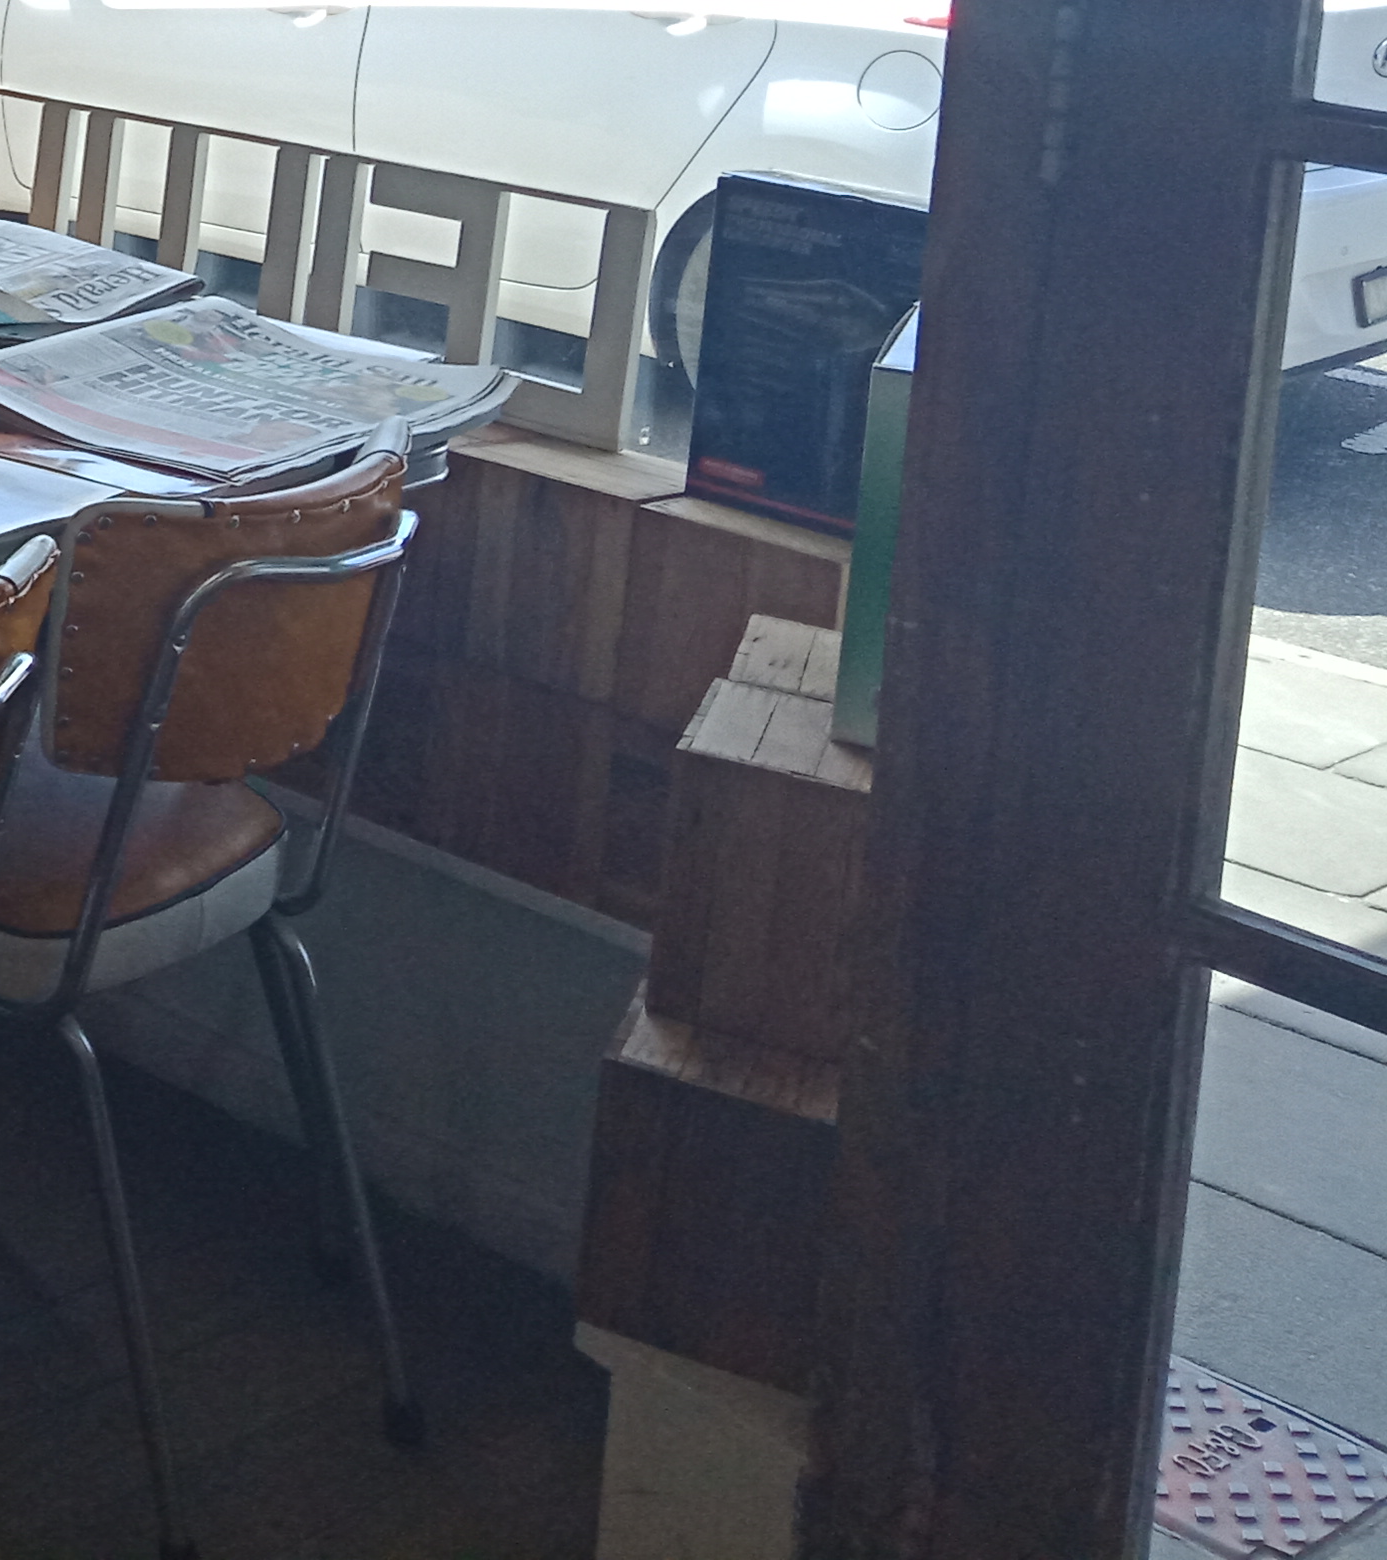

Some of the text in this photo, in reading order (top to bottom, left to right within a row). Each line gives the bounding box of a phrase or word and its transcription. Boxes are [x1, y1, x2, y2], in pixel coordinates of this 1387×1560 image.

[47, 266, 165, 310] Herald
[121, 364, 259, 402] HUNT
[250, 402, 355, 430] FOR
